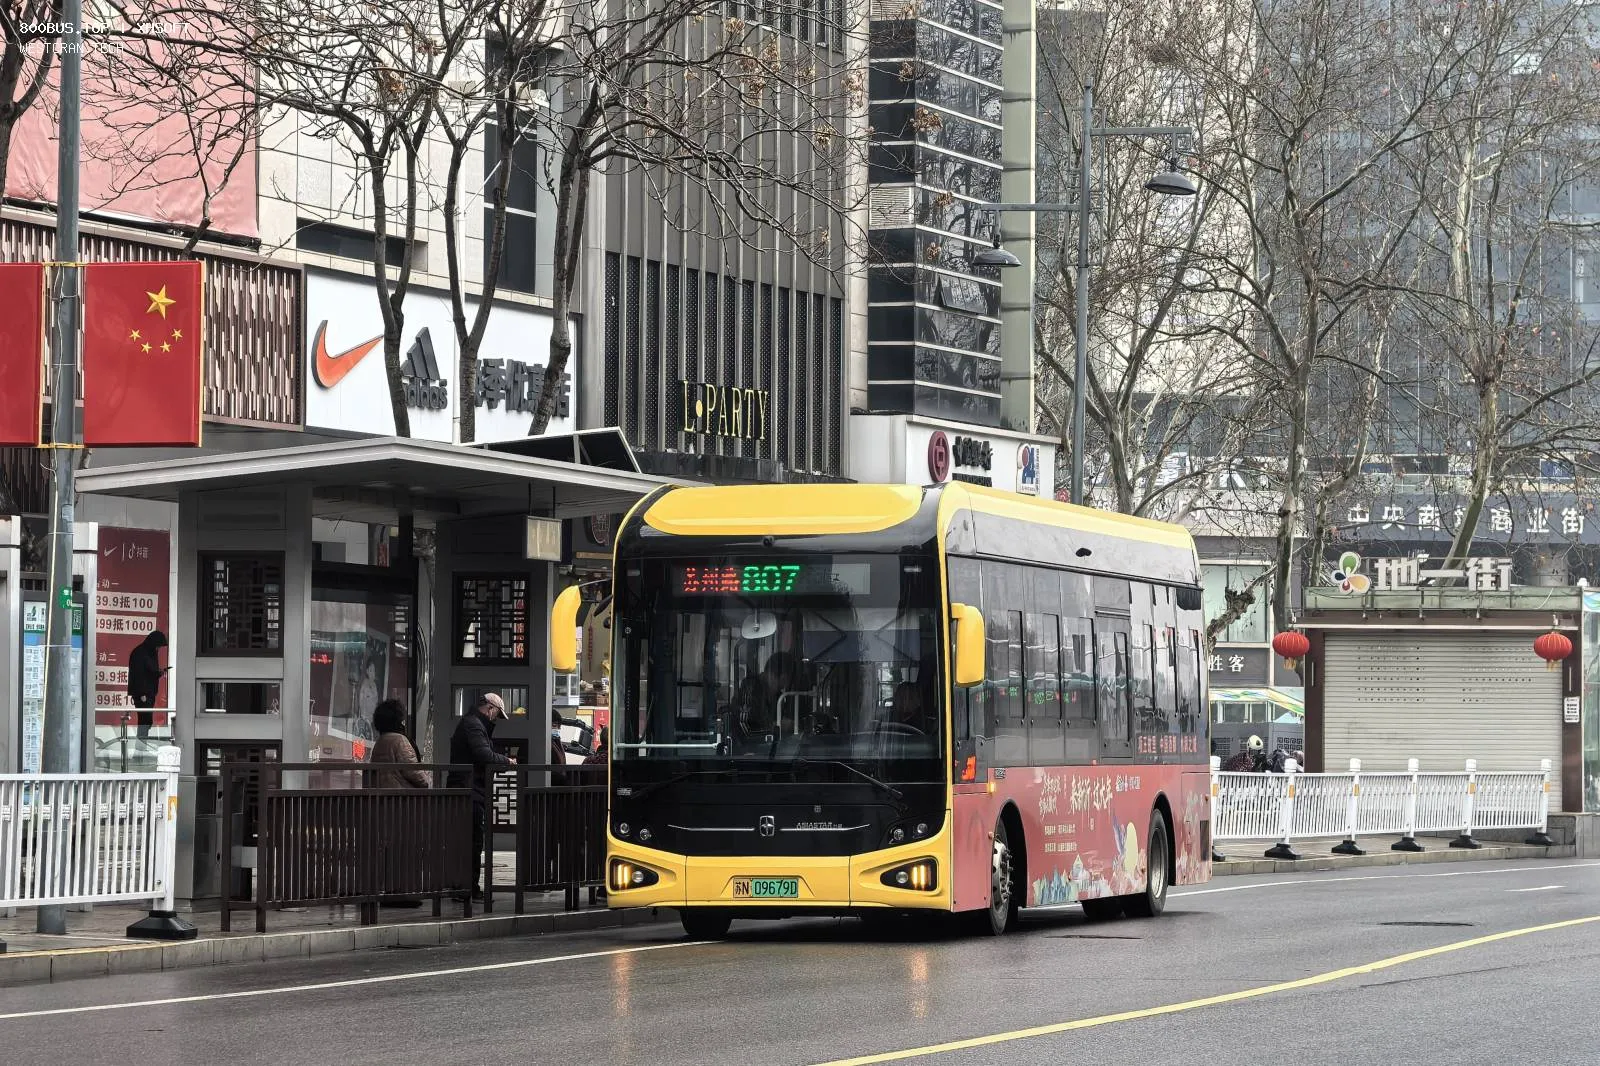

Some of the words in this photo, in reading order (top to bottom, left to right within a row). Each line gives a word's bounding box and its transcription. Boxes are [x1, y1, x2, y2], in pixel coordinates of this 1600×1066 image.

[402, 377, 448, 410] didas
[742, 564, 800, 592] 807
[96, 617, 153, 632] 99抵1000
